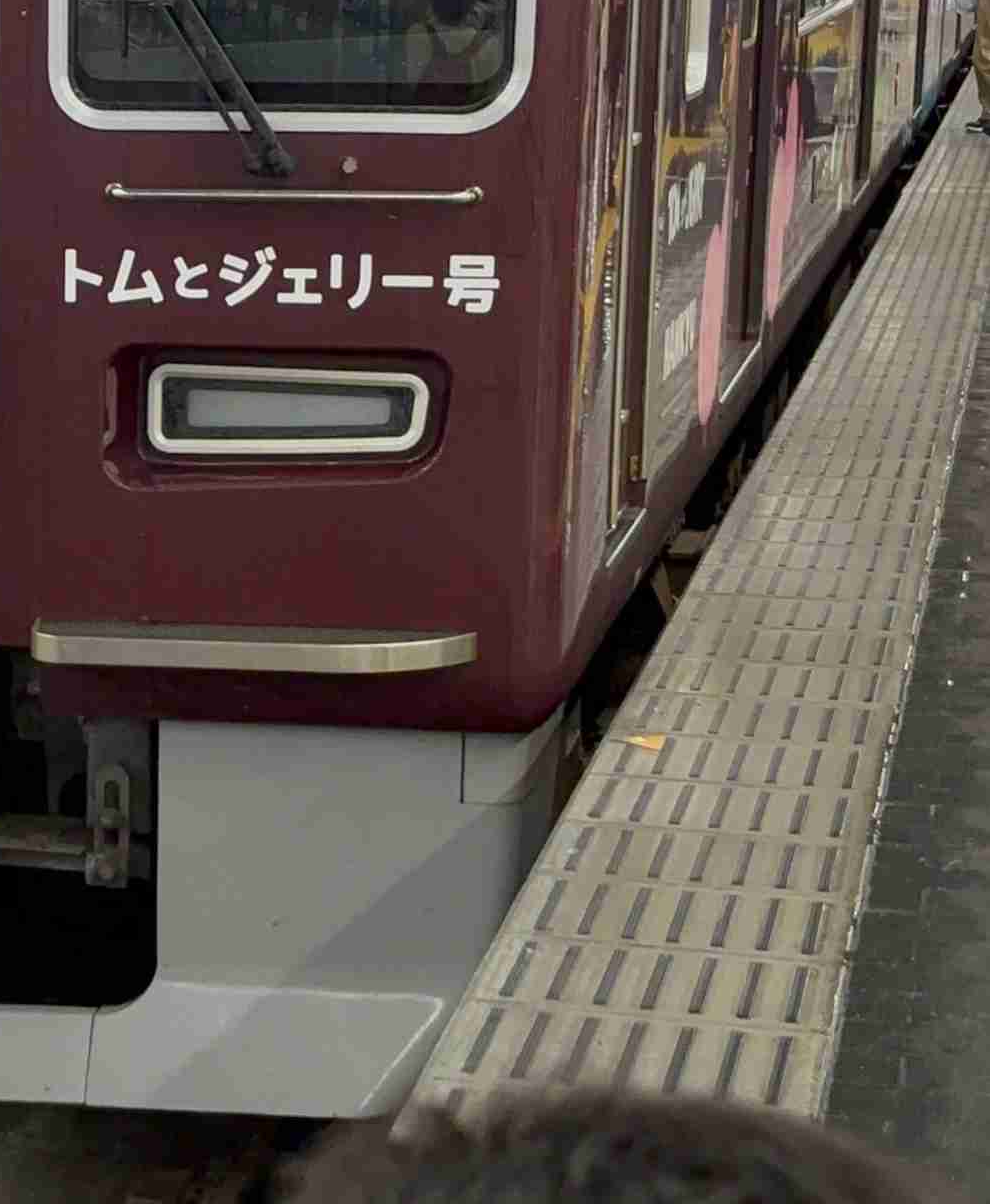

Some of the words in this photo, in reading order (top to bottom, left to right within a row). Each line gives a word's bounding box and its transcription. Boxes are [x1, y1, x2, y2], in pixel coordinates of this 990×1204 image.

[64, 246, 501, 314] トムとジェリー号
